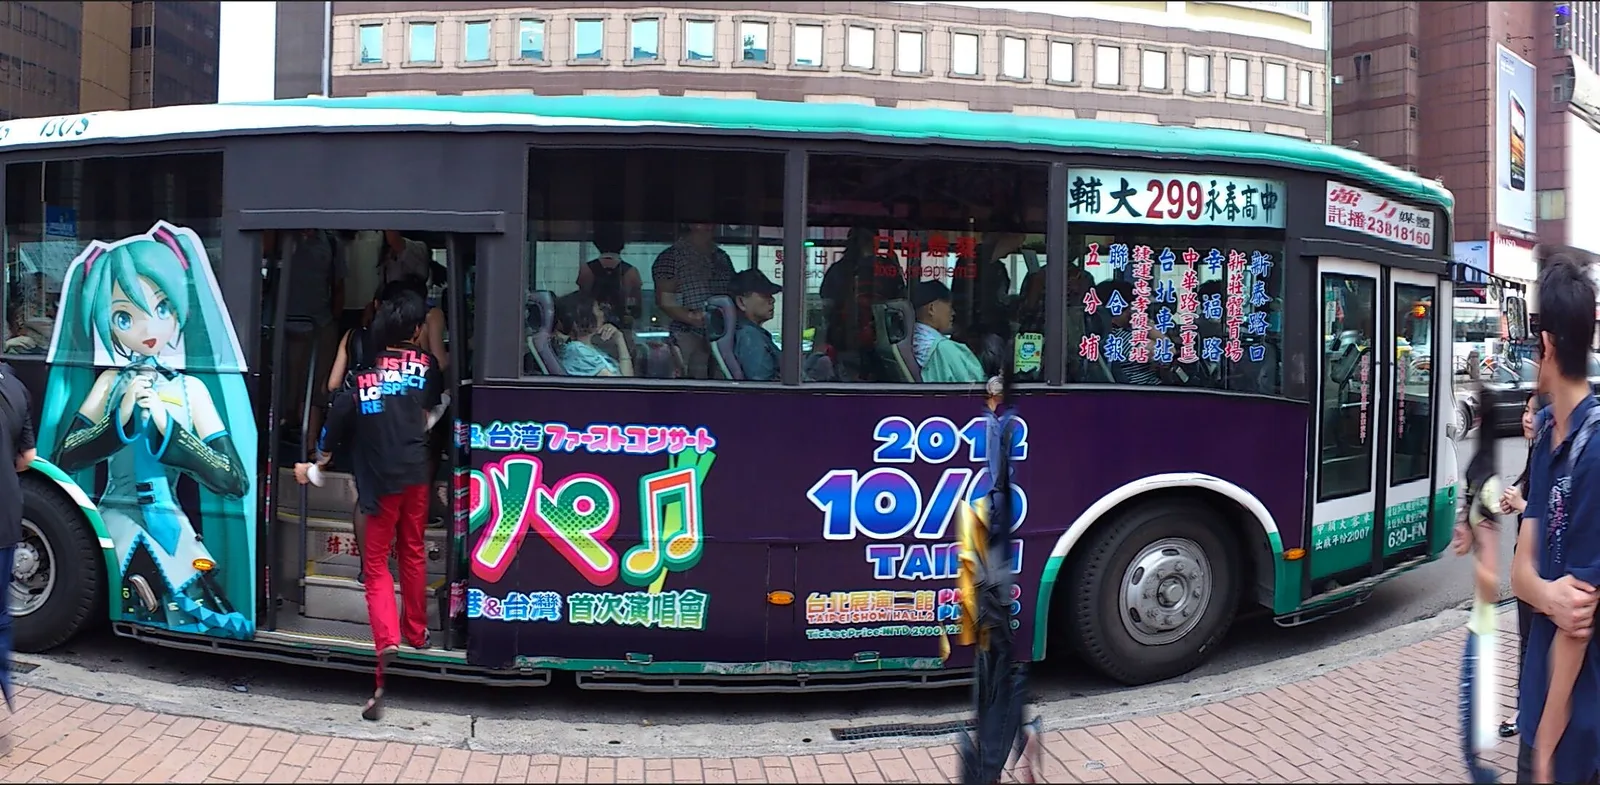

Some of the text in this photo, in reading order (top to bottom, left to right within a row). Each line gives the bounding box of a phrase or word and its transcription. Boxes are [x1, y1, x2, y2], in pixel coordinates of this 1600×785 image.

[1069, 176, 1278, 224] 輔大 299 永春高中
[1079, 242, 1102, 361] 五分埔
[1103, 243, 1129, 362] 聯合報
[1128, 245, 1154, 363] 捷運忠孝復興站
[1153, 247, 1177, 363] 台北車站
[1201, 248, 1225, 362] 幸福路
[1224, 249, 1247, 363] 新莊體育場
[1248, 250, 1273, 362] 新泰路口
[544, 423, 716, 453] ファーストコンサート
[568, 590, 710, 629] 首次演唱會
[807, 590, 936, 613] 台北展演二館
[866, 540, 1023, 580] TAII
[807, 612, 851, 625] TAIPEI
